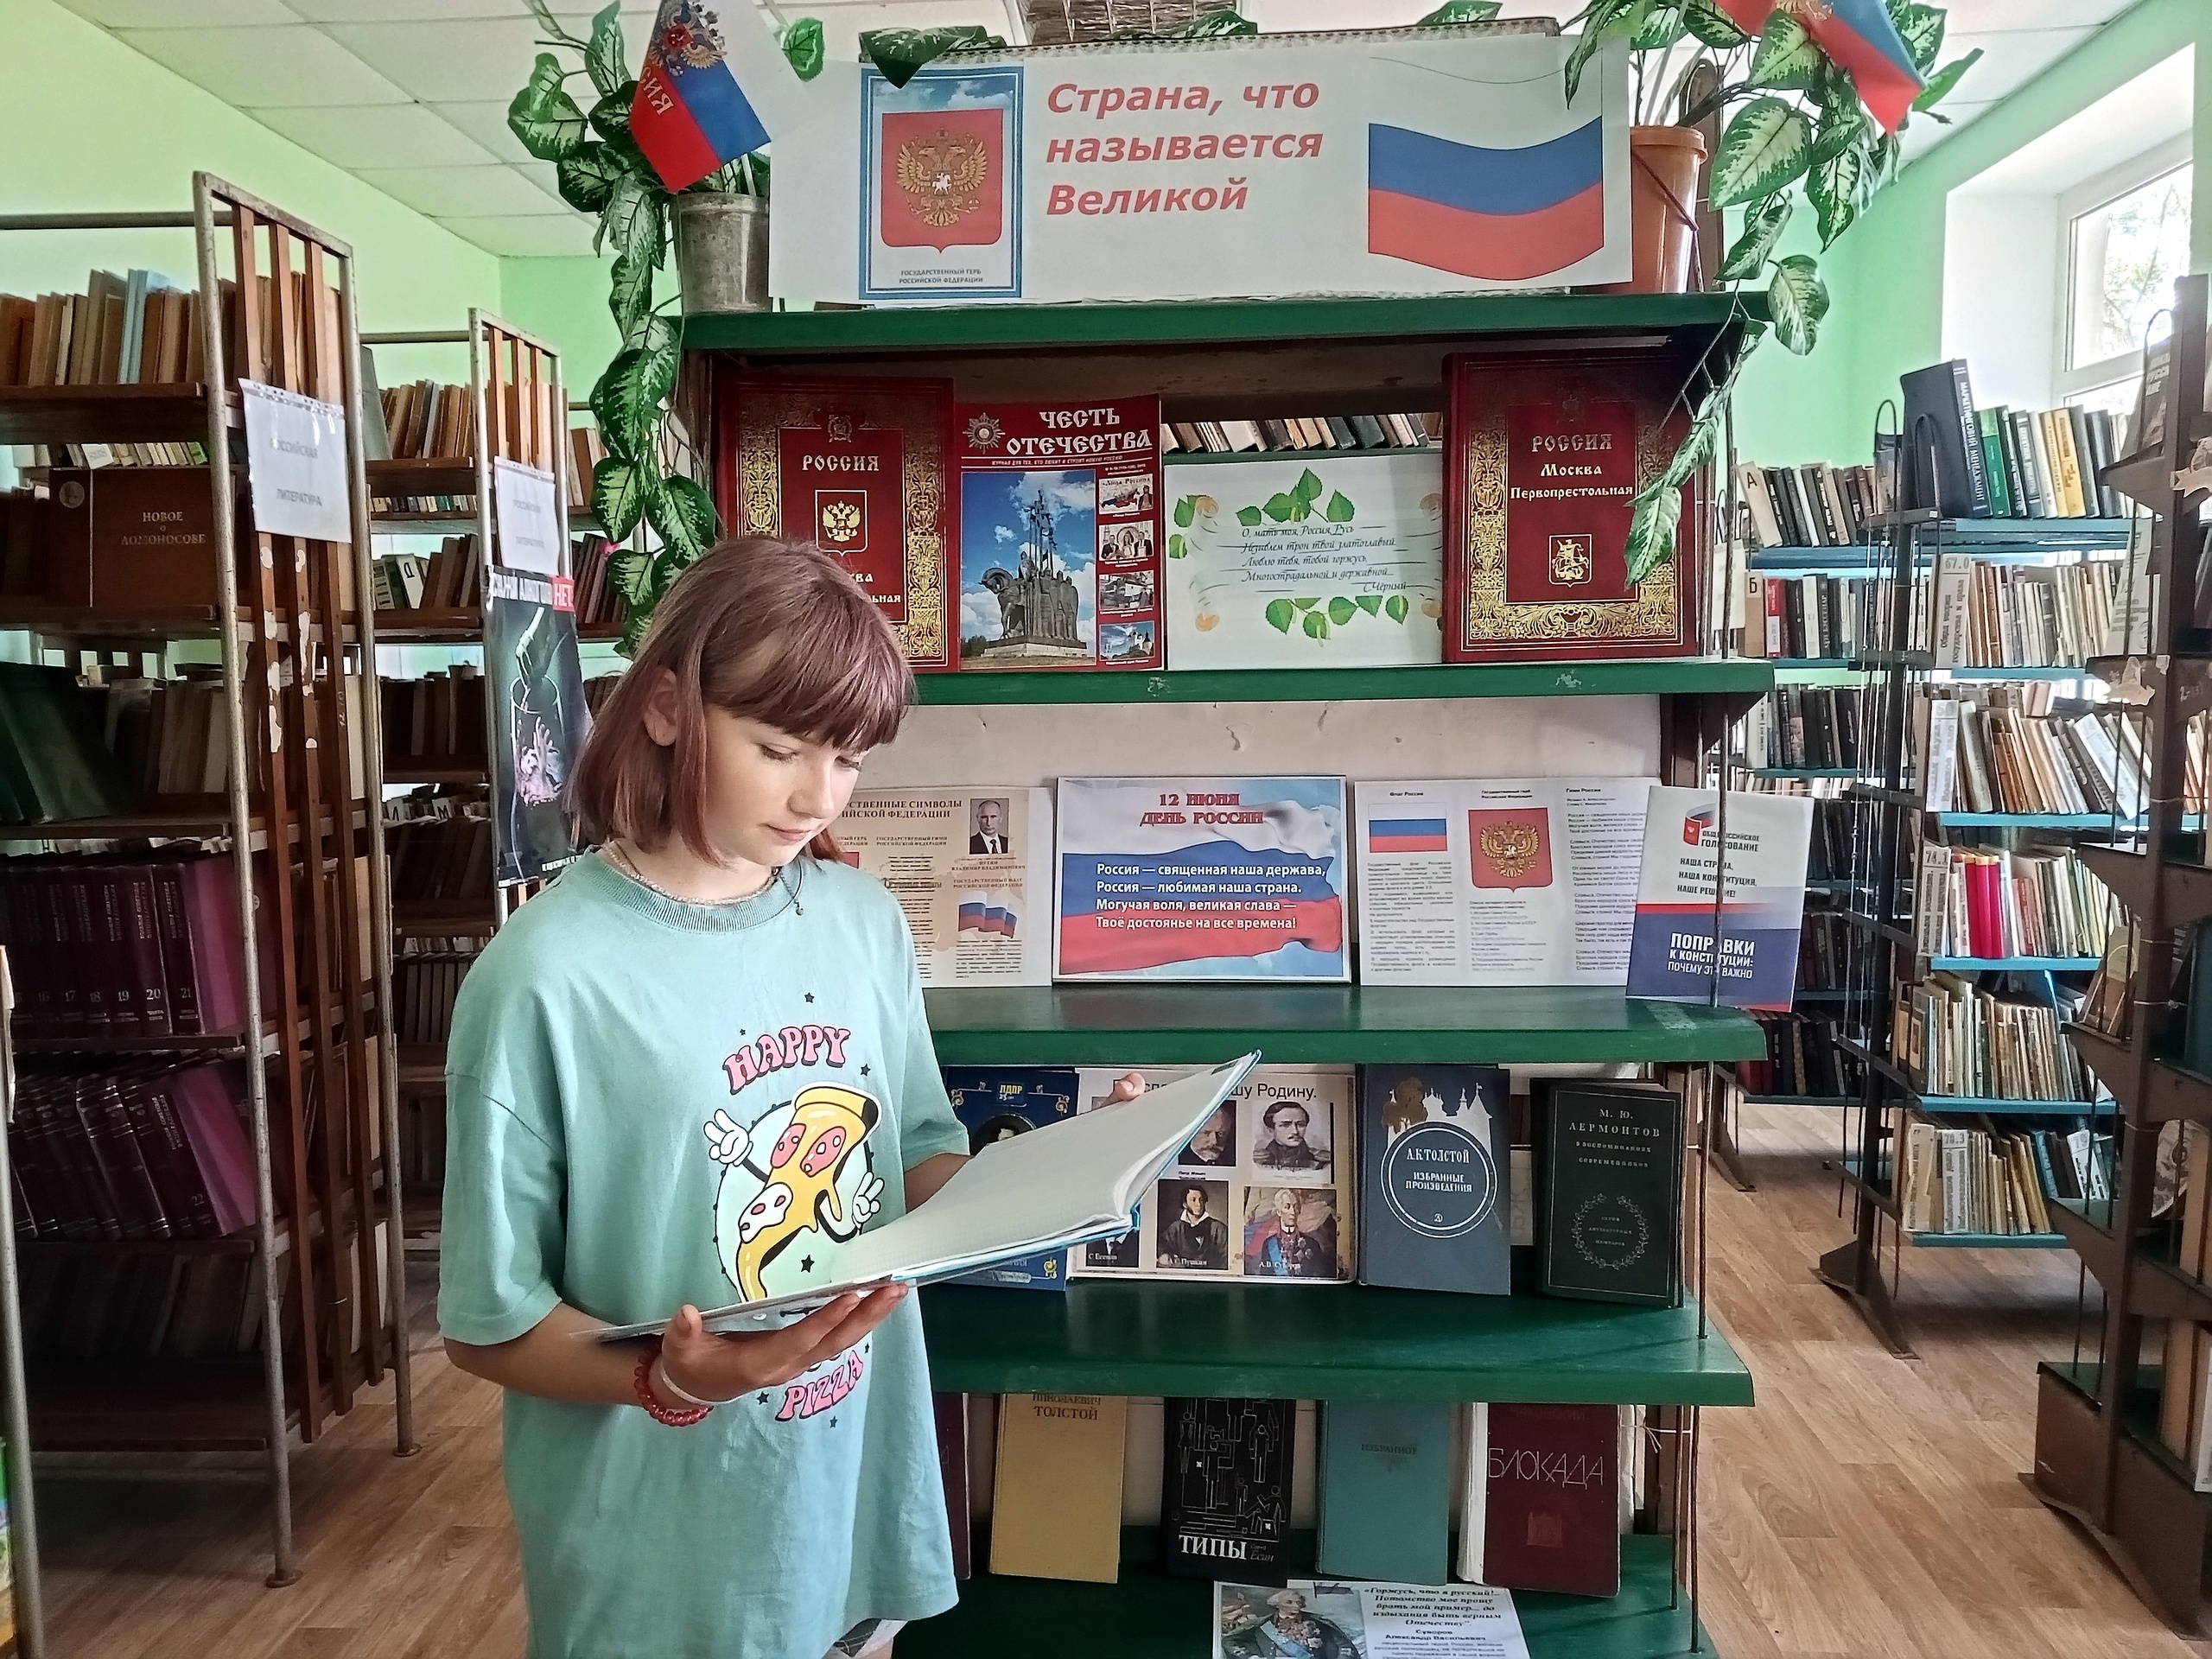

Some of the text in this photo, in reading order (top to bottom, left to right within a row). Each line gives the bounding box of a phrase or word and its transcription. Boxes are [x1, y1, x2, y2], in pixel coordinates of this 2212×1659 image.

[1047, 82, 1320, 118] Страна, что
[1046, 129, 1323, 164] называется
[1046, 176, 1249, 215] Великой
[1039, 407, 1120, 429] ЧЕСТЬ
[1006, 429, 1153, 455] ОТЕЧЕСТВА
[1530, 433, 1613, 453] РОССИЯ
[802, 454, 880, 472] РОССИЯ
[1540, 463, 1603, 478] Москва
[1747, 471, 1758, 489] А
[1510, 486, 1634, 502] Первопрестольная
[143, 512, 184, 522] НОВОЕ
[121, 533, 206, 545] ЛОМОНОСОВЕ
[1286, 540, 1309, 551] трон
[1312, 539, 1335, 550] твой
[1242, 556, 1275, 568] Люблю
[1302, 556, 1330, 564] тобой
[1945, 556, 1970, 570] 67.0
[1749, 576, 1758, 594] Б
[908, 799, 963, 809] СИМВОЛЫ
[1159, 791, 1241, 807] 12 ИЮНЯ
[887, 809, 951, 819] ФЕДЕРАЦИИ
[1140, 810, 1264, 828] ДЕНЬ РОССИИ
[1680, 858, 1702, 868] НАША
[1925, 851, 1948, 865] 74.1
[1096, 864, 1327, 880] Россия священная наша держава,
[1678, 871, 1758, 887] НАША КОНТИТУЦИЯ,
[1096, 881, 1302, 896] Россия любимая наша страна.
[1677, 884, 1698, 894] НАШЕ
[1096, 899, 1281, 914] Могучая воля, великая слава
[1096, 916, 1297, 931] Твоё достоянье на все времена!
[1669, 949, 1677, 960] К
[1668, 961, 1753, 979] ПОЧЕМУ ЭТ ВАЖНО
[118, 990, 130, 1002] 19
[146, 988, 162, 1001] 20
[180, 988, 192, 999] 21
[722, 1024, 852, 1096] HAPPY
[999, 1084, 1023, 1096] ЛДПР
[1232, 1083, 1318, 1103] шу Родину.
[1599, 1109, 1634, 1120] М. Ю.
[1568, 1122, 1661, 1137] ЛЕРМОНТОВ
[1579, 1157, 1649, 1168] СОВРЕМЕННИКОВ
[1413, 1171, 1465, 1183] ИЗБРАННЫЕ
[1405, 1180, 1472, 1192] ПРОИЗВЕДЕНИЯ
[774, 1349, 865, 1422] PIZZA
[1033, 1405, 1098, 1421] ТОЛСТОЙ
[1488, 1447, 1604, 1491] БЛОКАДА
[1178, 1534, 1248, 1560] ТИПЫ
